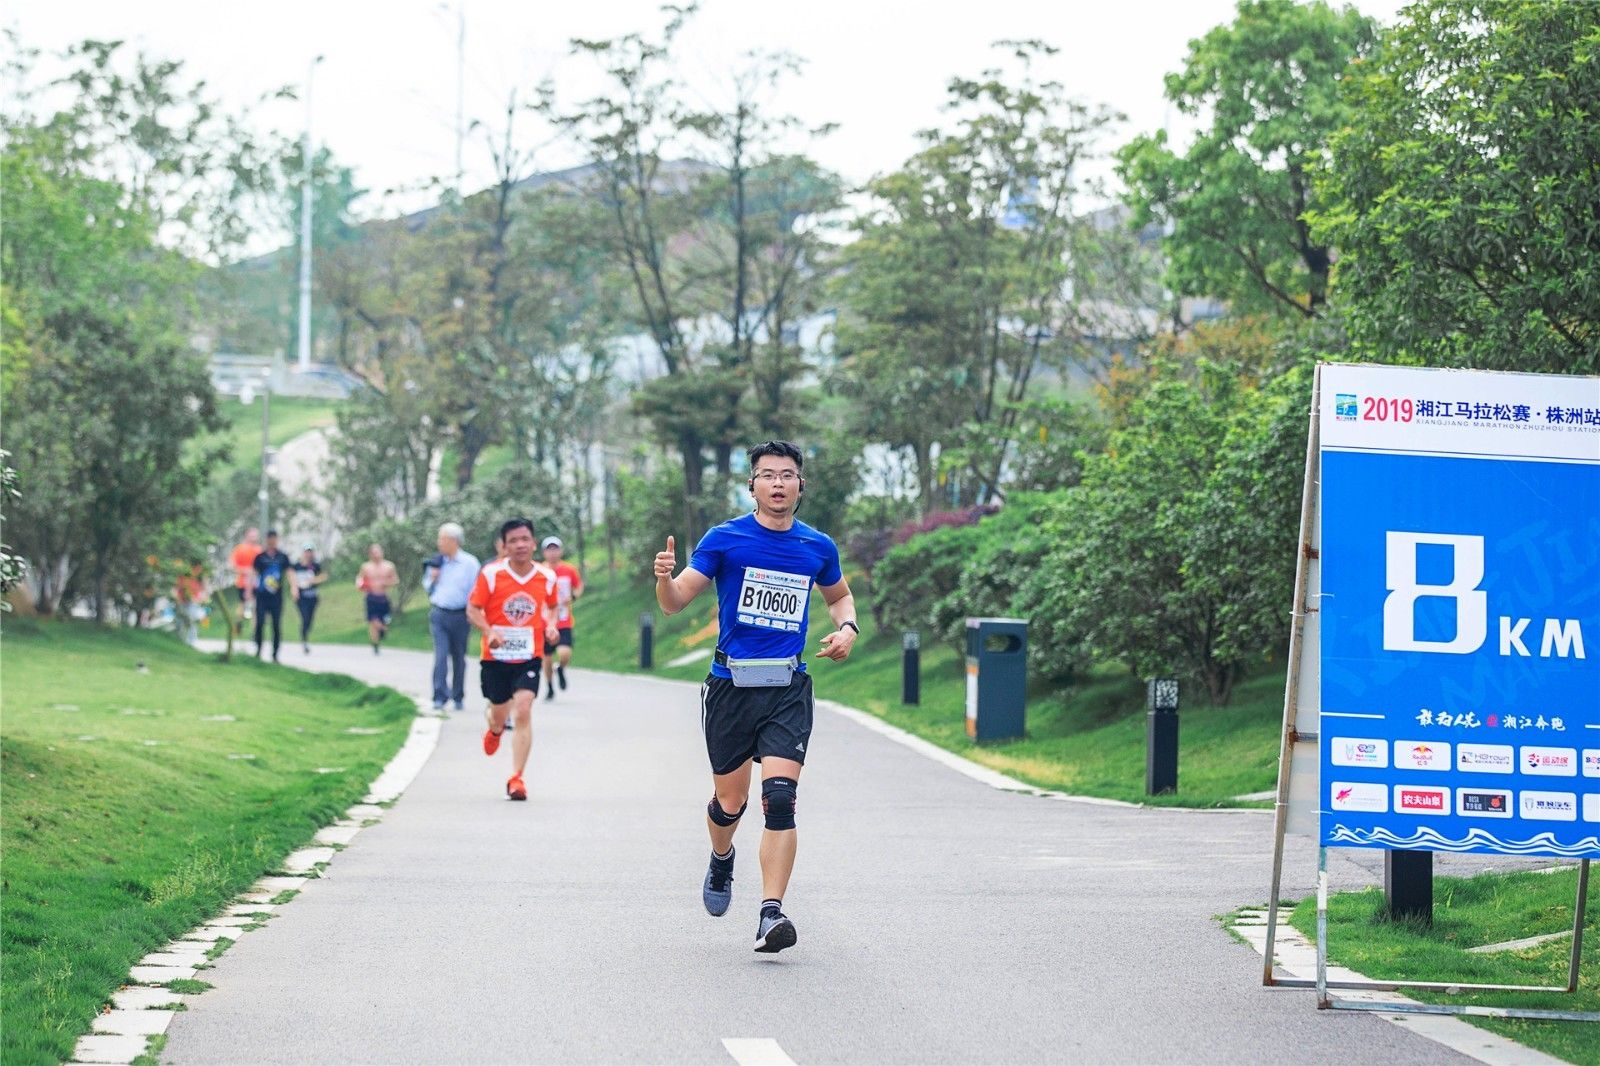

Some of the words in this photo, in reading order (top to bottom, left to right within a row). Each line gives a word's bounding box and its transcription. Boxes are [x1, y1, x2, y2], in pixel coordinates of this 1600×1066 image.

[1363, 396, 1413, 422] 2019
[1416, 418, 1469, 427] XIANGJIANG
[1473, 421, 1521, 430] MARATHON
[1523, 424, 1564, 432] ZHUZHOU
[742, 586, 797, 615] B10600
[1383, 531, 1487, 655] 8
[1499, 616, 1586, 659] KM
[1403, 795, 1441, 807] 农夫山泉
